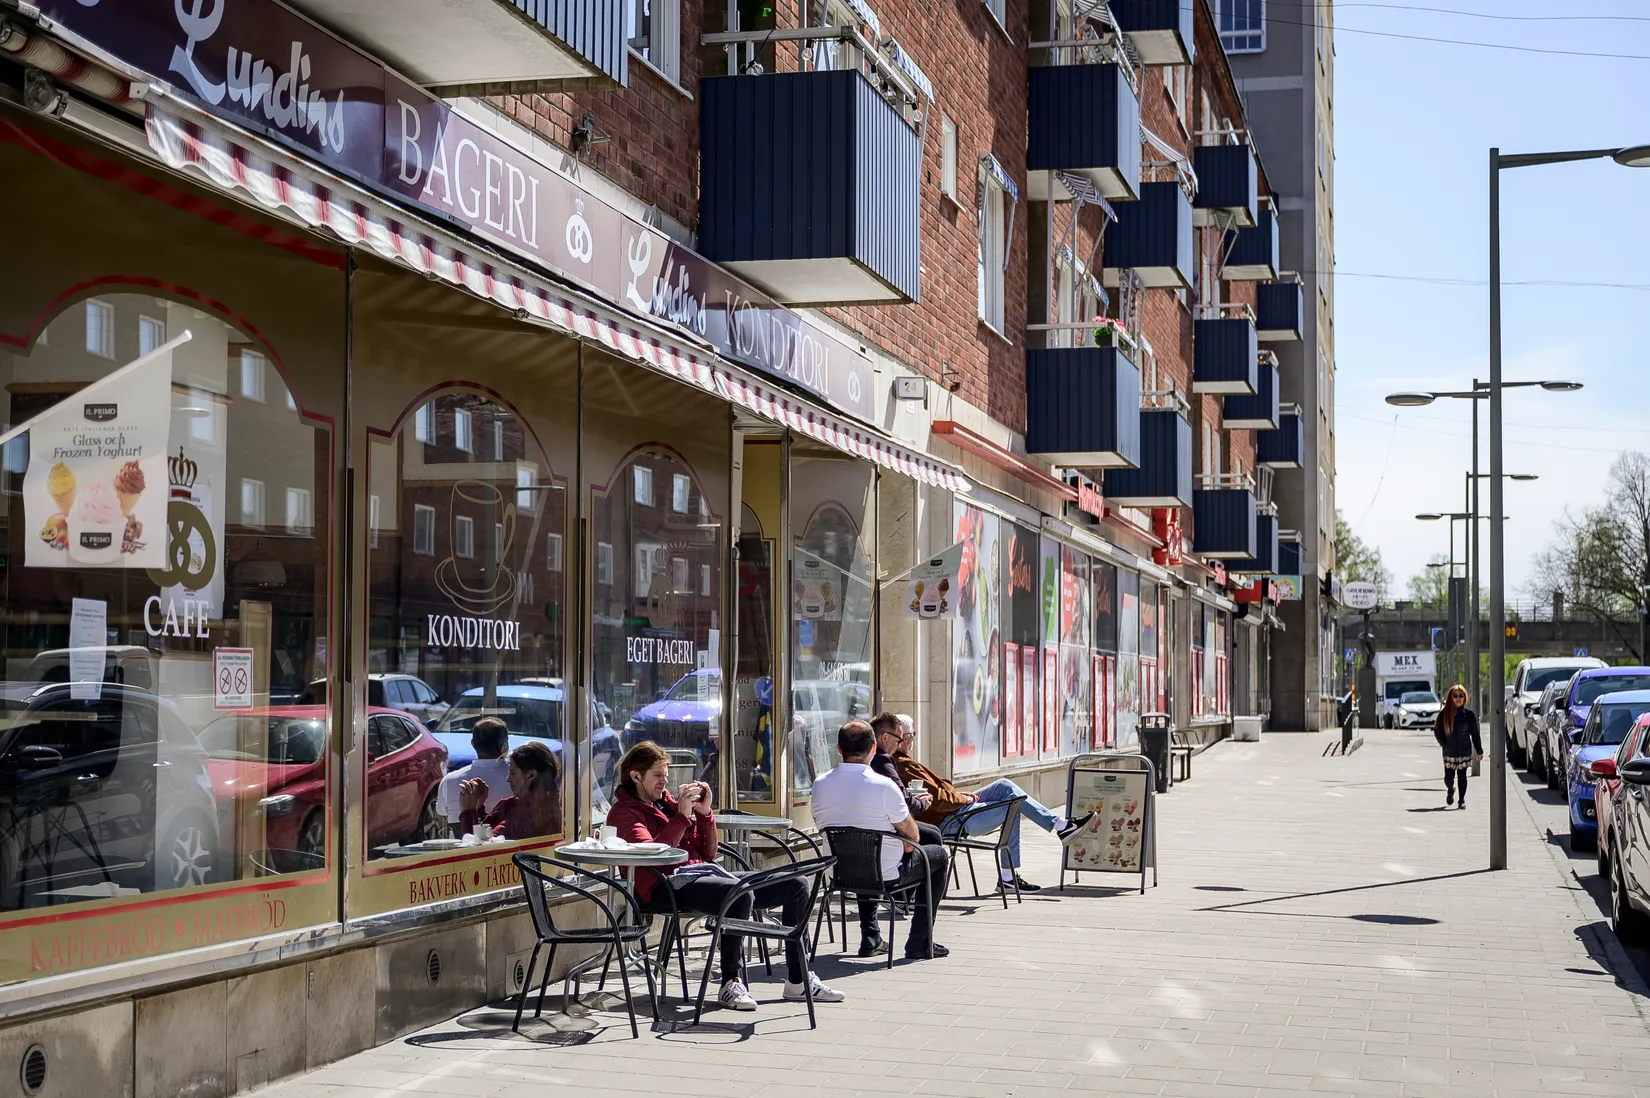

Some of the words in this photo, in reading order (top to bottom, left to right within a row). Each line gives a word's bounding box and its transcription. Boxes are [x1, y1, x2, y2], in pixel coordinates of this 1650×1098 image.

[168, 0, 345, 154] Lundins
[397, 98, 540, 250] BAGERI
[626, 230, 706, 336] Lundins
[723, 288, 830, 395] KONDITORI
[904, 381, 917, 393] 24
[93, 407, 117, 416] PRIMO
[53, 446, 93, 459] Frozen
[97, 445, 143, 459] Yoghurt
[72, 434, 102, 446] Glass
[104, 432, 126, 446] och
[89, 536, 111, 544] PRIMO
[144, 595, 210, 638] CAFE
[427, 614, 520, 650] KONDITORI
[626, 636, 655, 664] EGET
[656, 638, 694, 665] BAGERI
[1393, 655, 1419, 666] MEX
[409, 870, 467, 904] BAKVERK
[485, 858, 523, 888] TÅRTO
[30, 908, 166, 973] KAFFEBRÖD
[193, 893, 287, 943] MATBRÖD
